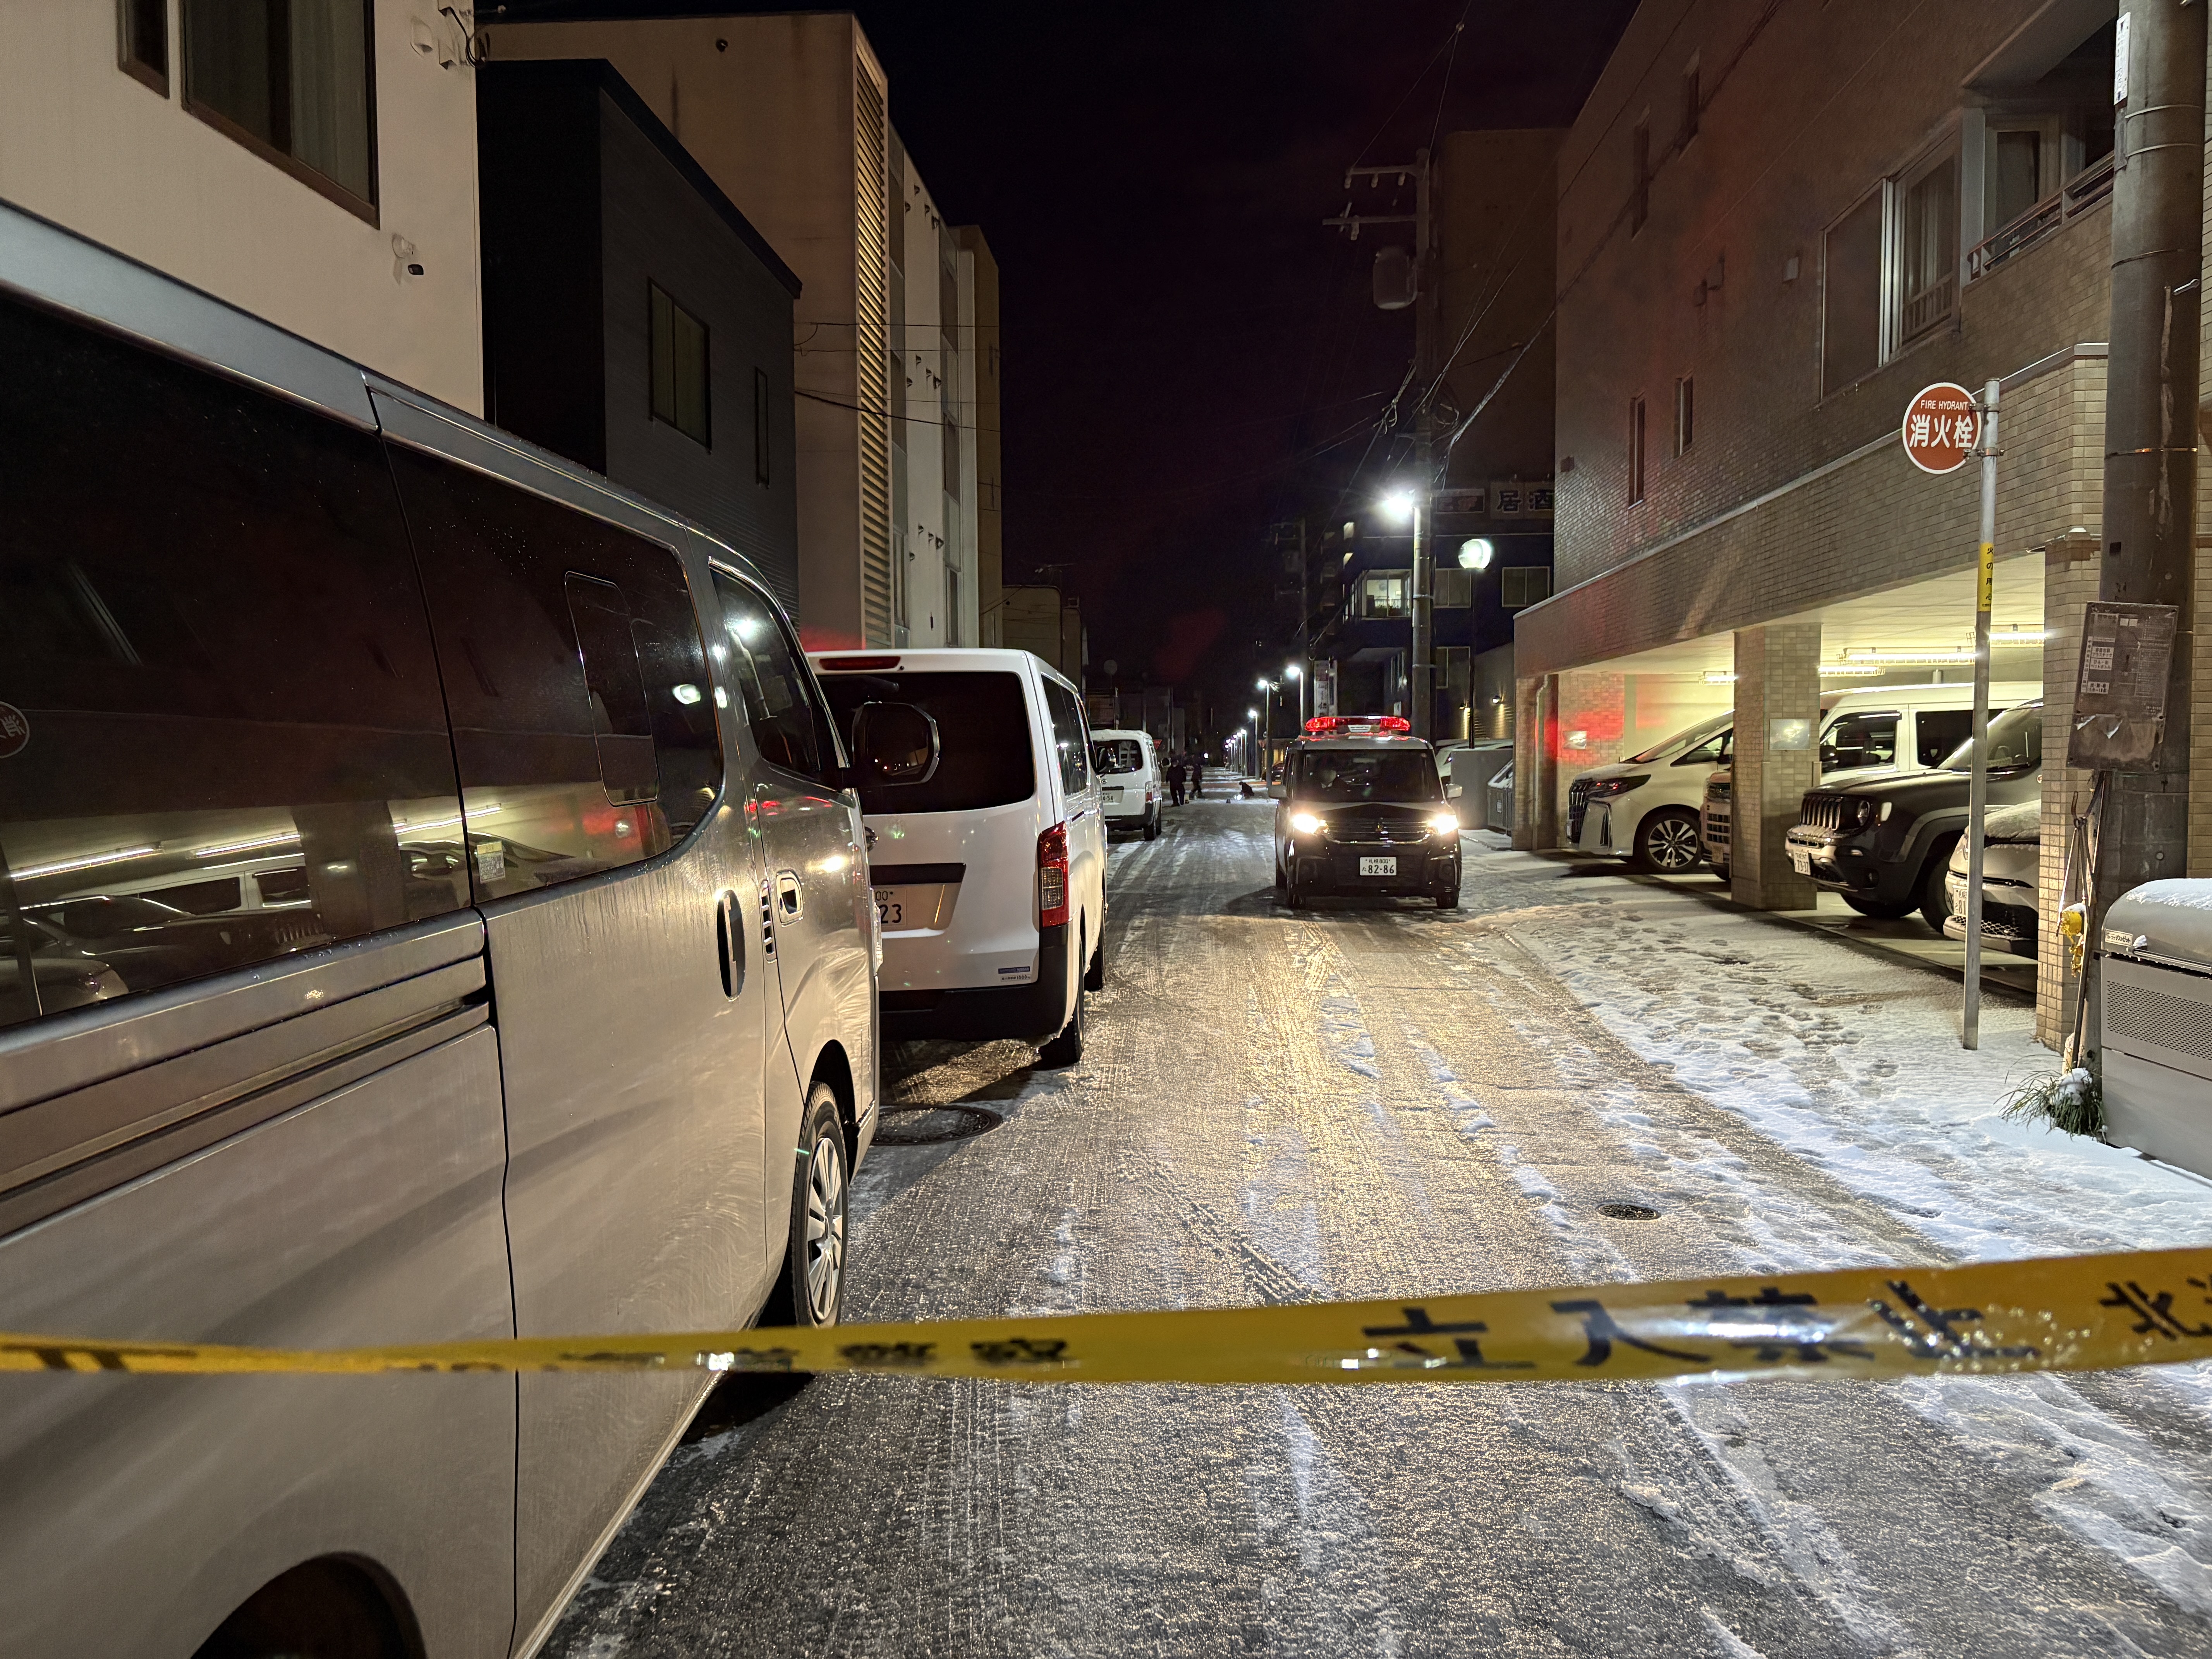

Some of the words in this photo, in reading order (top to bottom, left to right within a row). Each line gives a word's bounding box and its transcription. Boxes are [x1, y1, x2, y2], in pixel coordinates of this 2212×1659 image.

[1920, 400, 1936, 409] FIRE
[1939, 400, 1968, 410] HYDRANT
[1909, 414, 1974, 448] 消火栓
[1368, 864, 1394, 874] 82-86
[1362, 1279, 2042, 1369] 立入禁止
